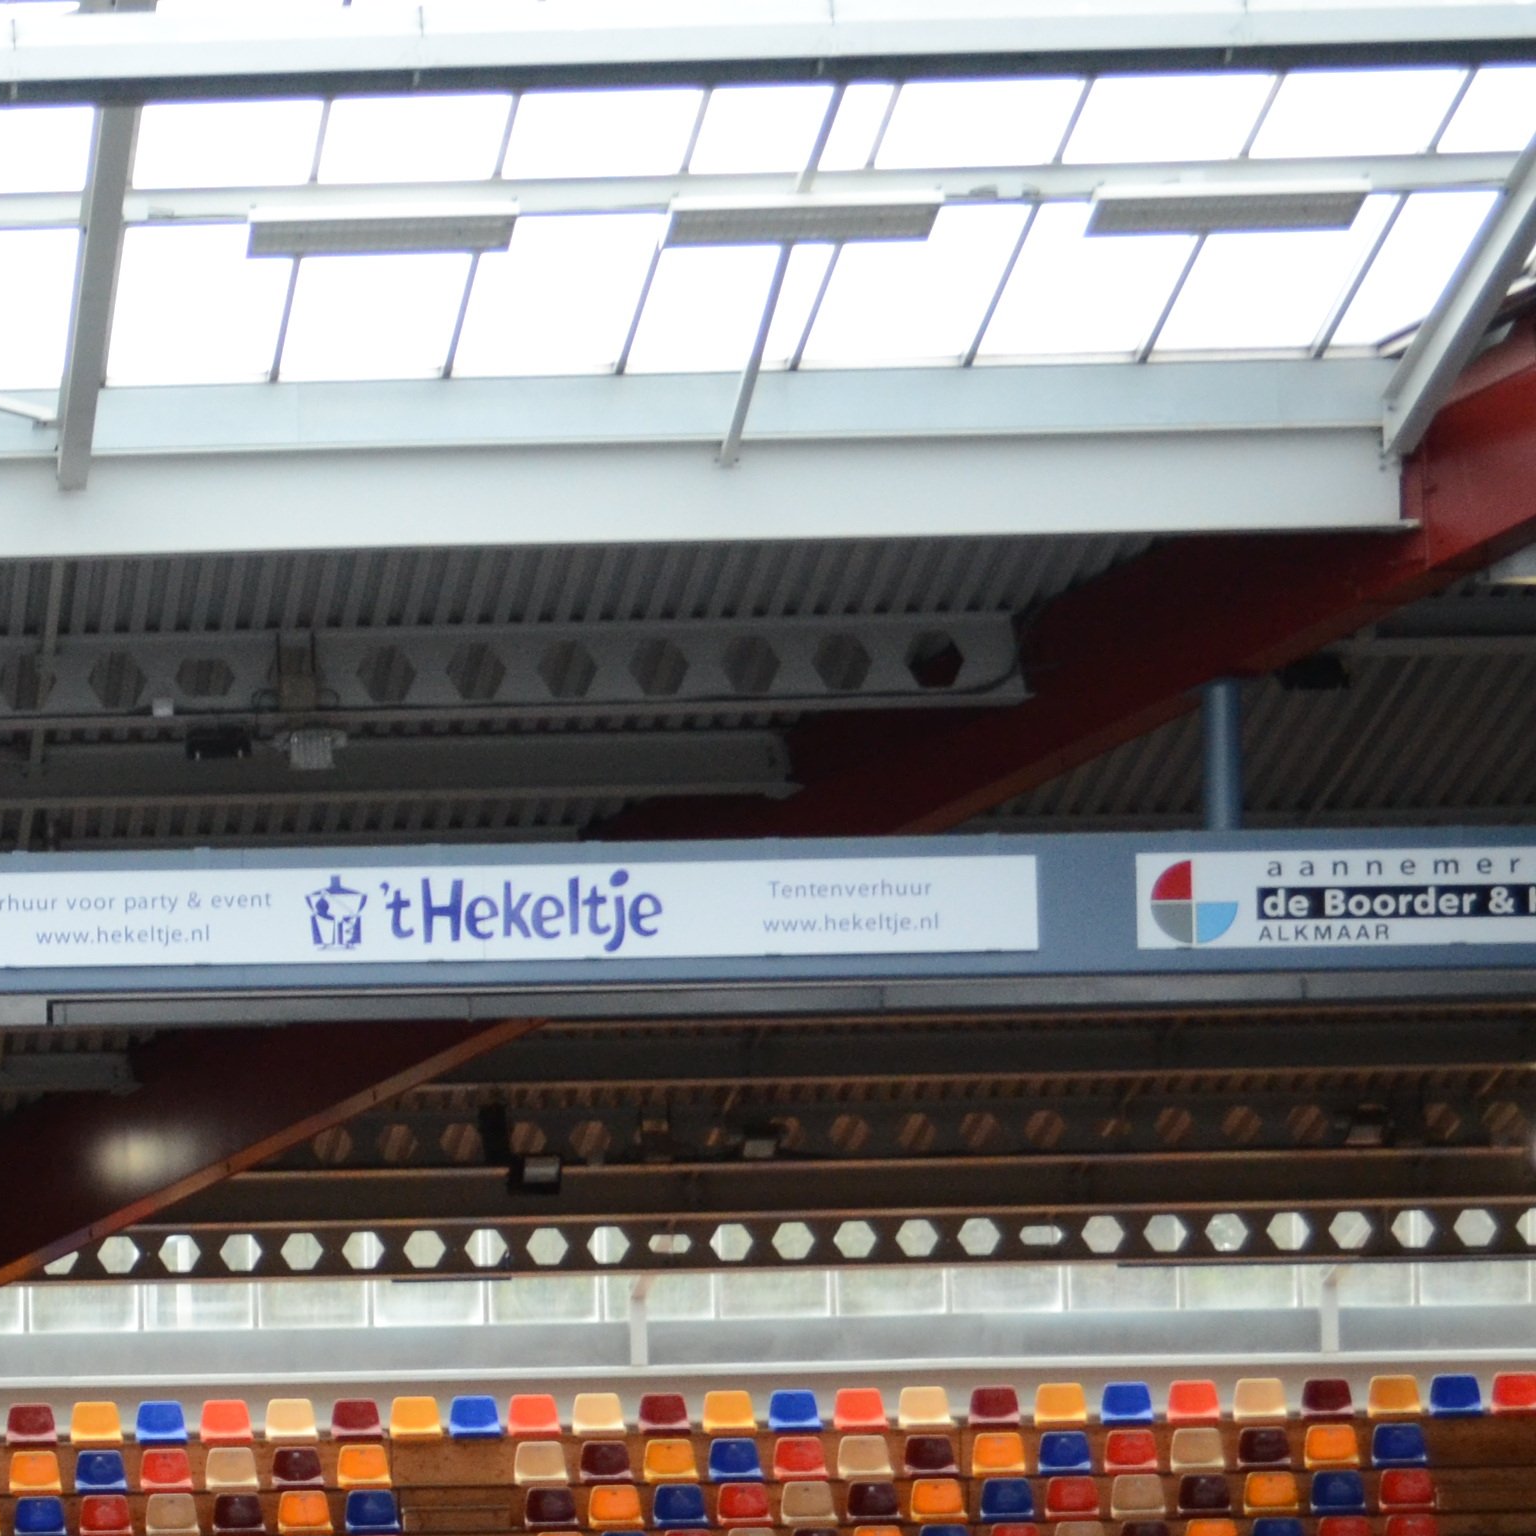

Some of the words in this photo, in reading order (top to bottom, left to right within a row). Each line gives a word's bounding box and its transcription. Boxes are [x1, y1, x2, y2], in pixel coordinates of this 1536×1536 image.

[1266, 856, 1522, 877] aannemer
[767, 879, 933, 898] Tentenverhuur
[66, 896, 117, 911] voor
[123, 892, 179, 915] party
[186, 891, 202, 909] &
[210, 890, 272, 909] event
[422, 868, 663, 953] Hekeltje
[1262, 887, 1311, 918] de
[1324, 884, 1477, 917] Boorder
[1488, 886, 1515, 912] &
[35, 923, 211, 948] www.hekeltje.nl
[762, 912, 941, 935] www.hekeltje.nl
[1259, 923, 1391, 942] ALKMAAR
